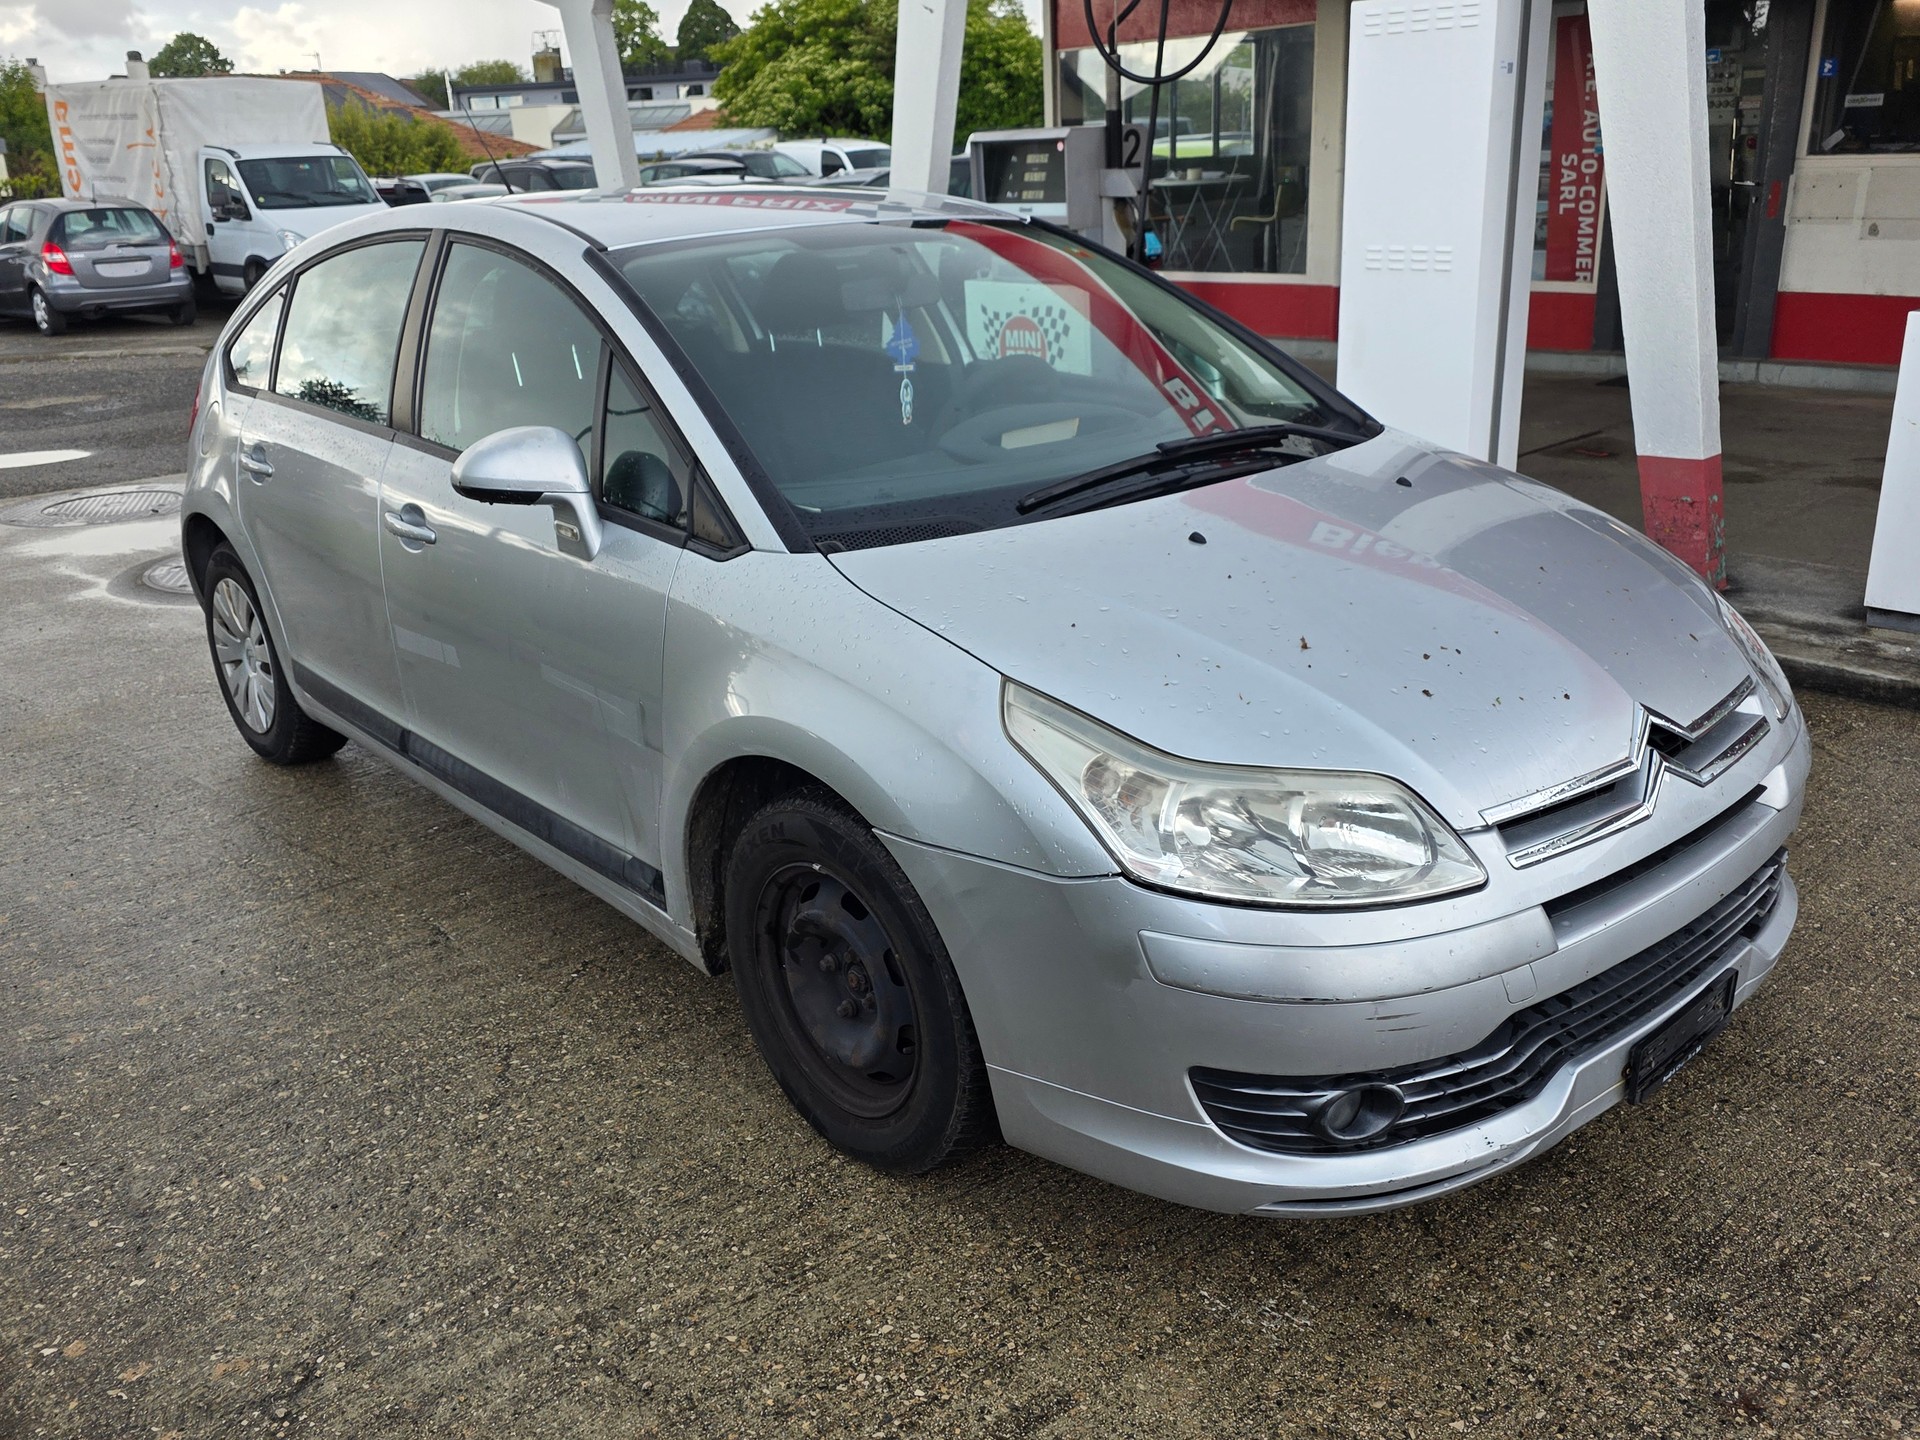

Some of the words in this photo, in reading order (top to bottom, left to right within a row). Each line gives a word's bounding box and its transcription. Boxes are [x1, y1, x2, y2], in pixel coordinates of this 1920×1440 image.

[1123, 128, 1141, 168] 2
[1558, 153, 1578, 215] SARL
[1005, 329, 1042, 349] MINI
